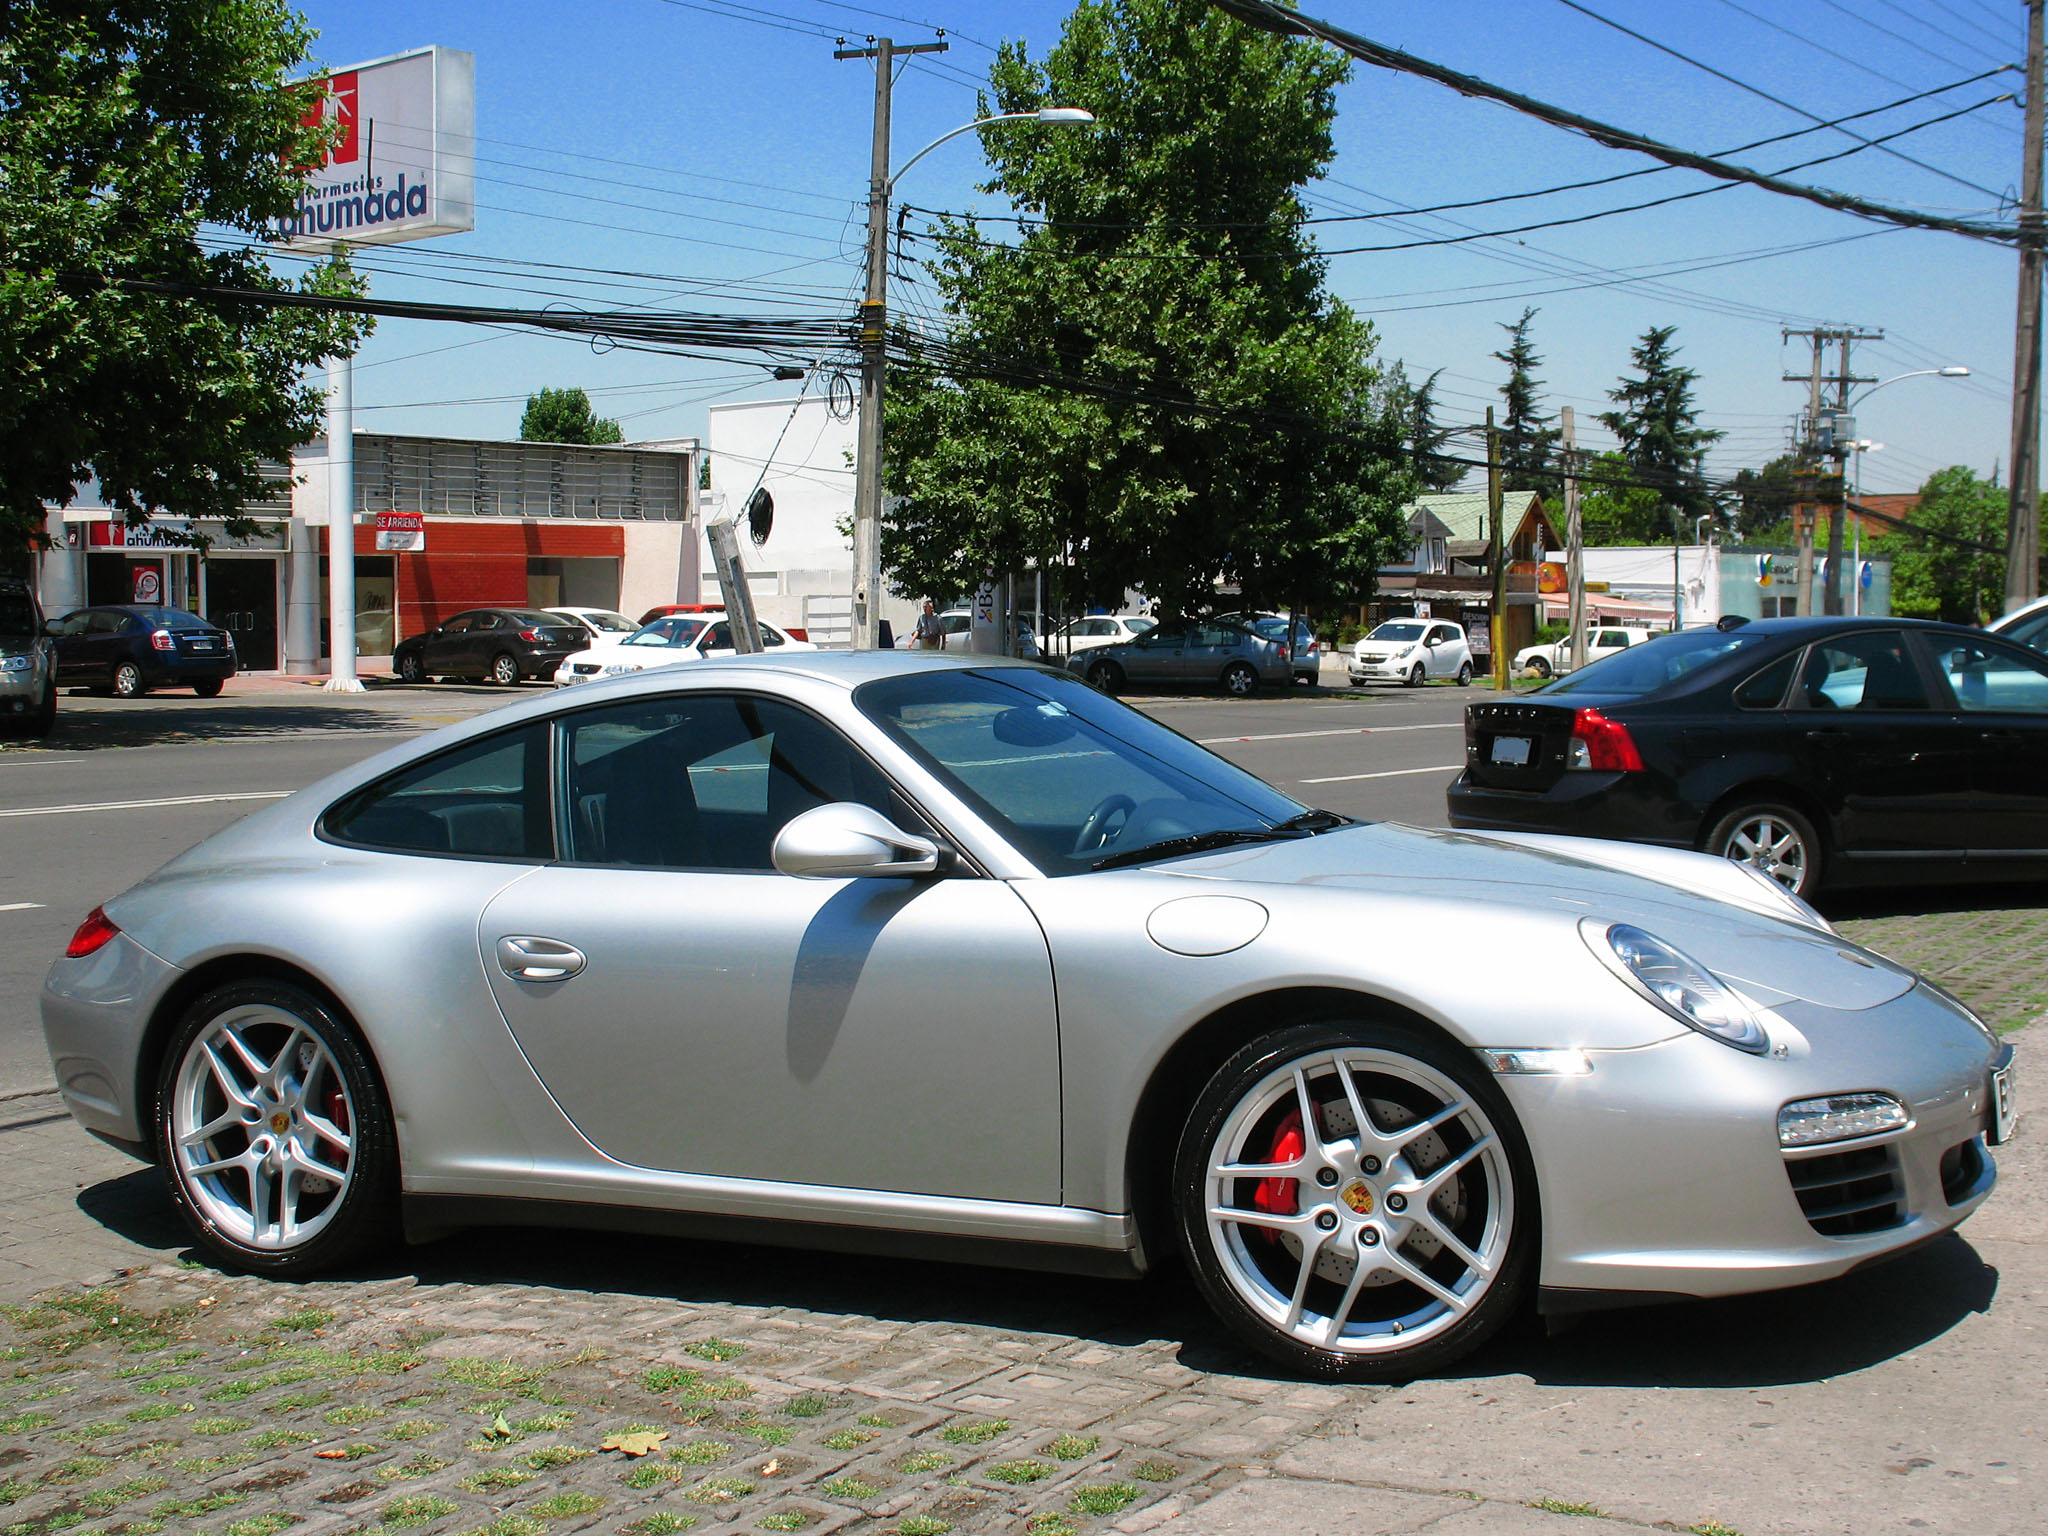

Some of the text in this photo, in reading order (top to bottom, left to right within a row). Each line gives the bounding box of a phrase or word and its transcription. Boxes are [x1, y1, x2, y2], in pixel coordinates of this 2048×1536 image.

[279, 173, 427, 237] ahumada
[376, 516, 423, 529] SE ARRIENDA
